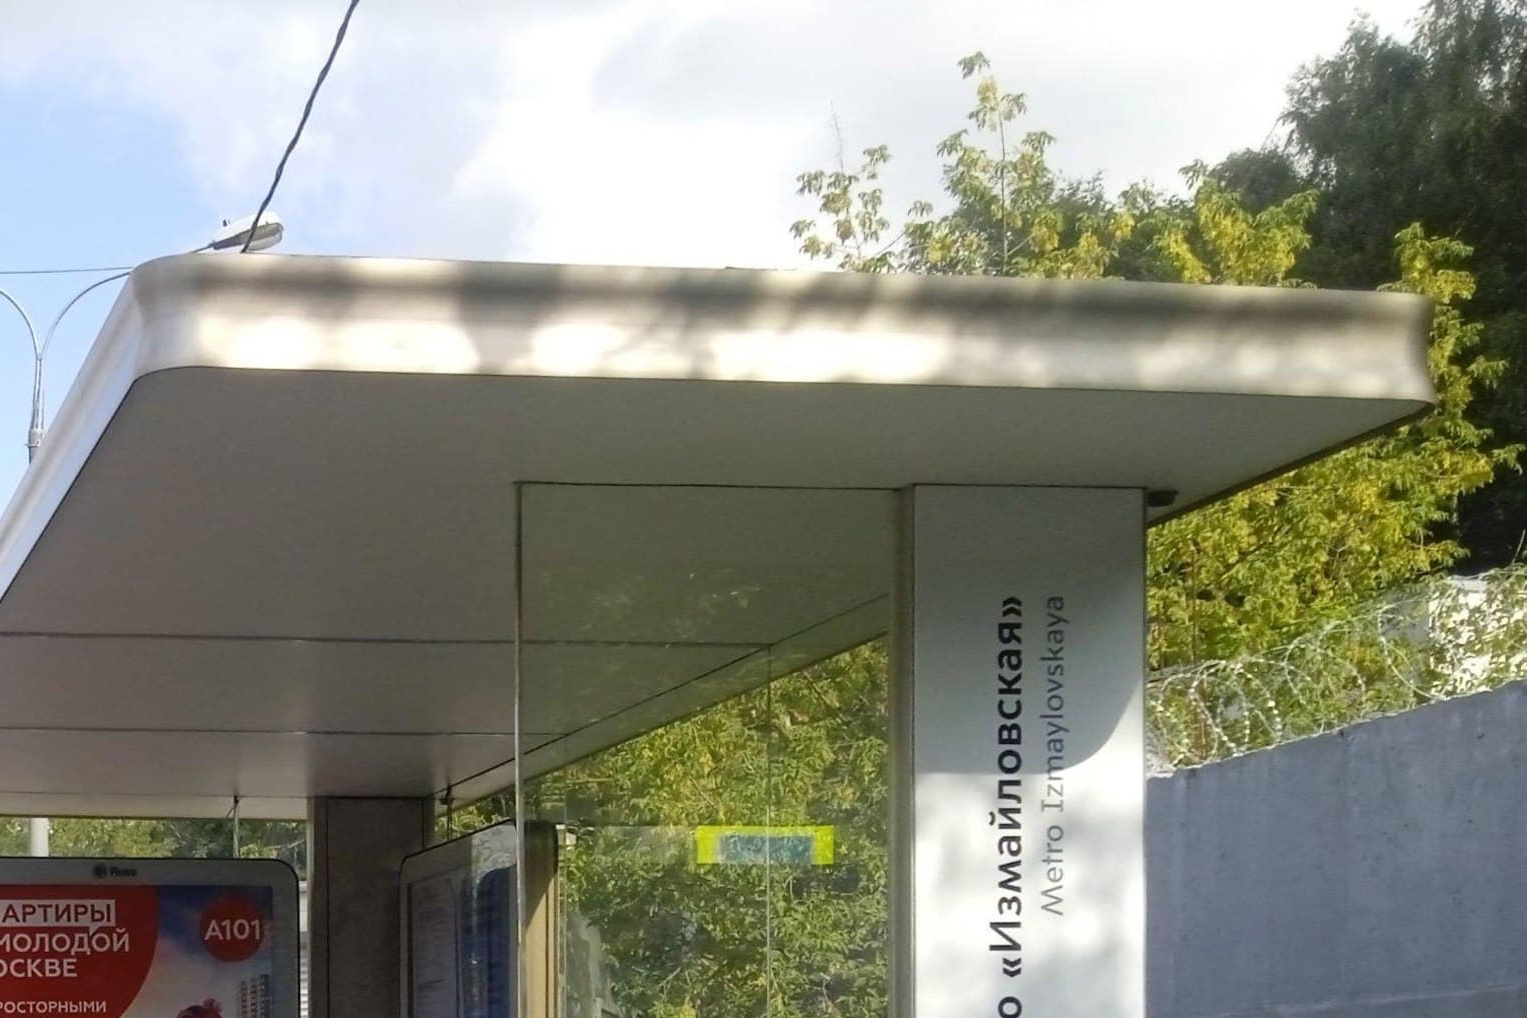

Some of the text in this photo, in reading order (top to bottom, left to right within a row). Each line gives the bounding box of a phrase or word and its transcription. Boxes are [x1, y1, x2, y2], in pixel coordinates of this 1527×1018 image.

[988, 595, 1023, 978] «Измайловская»
[1040, 595, 1070, 916] Metro Izmaylovskaya
